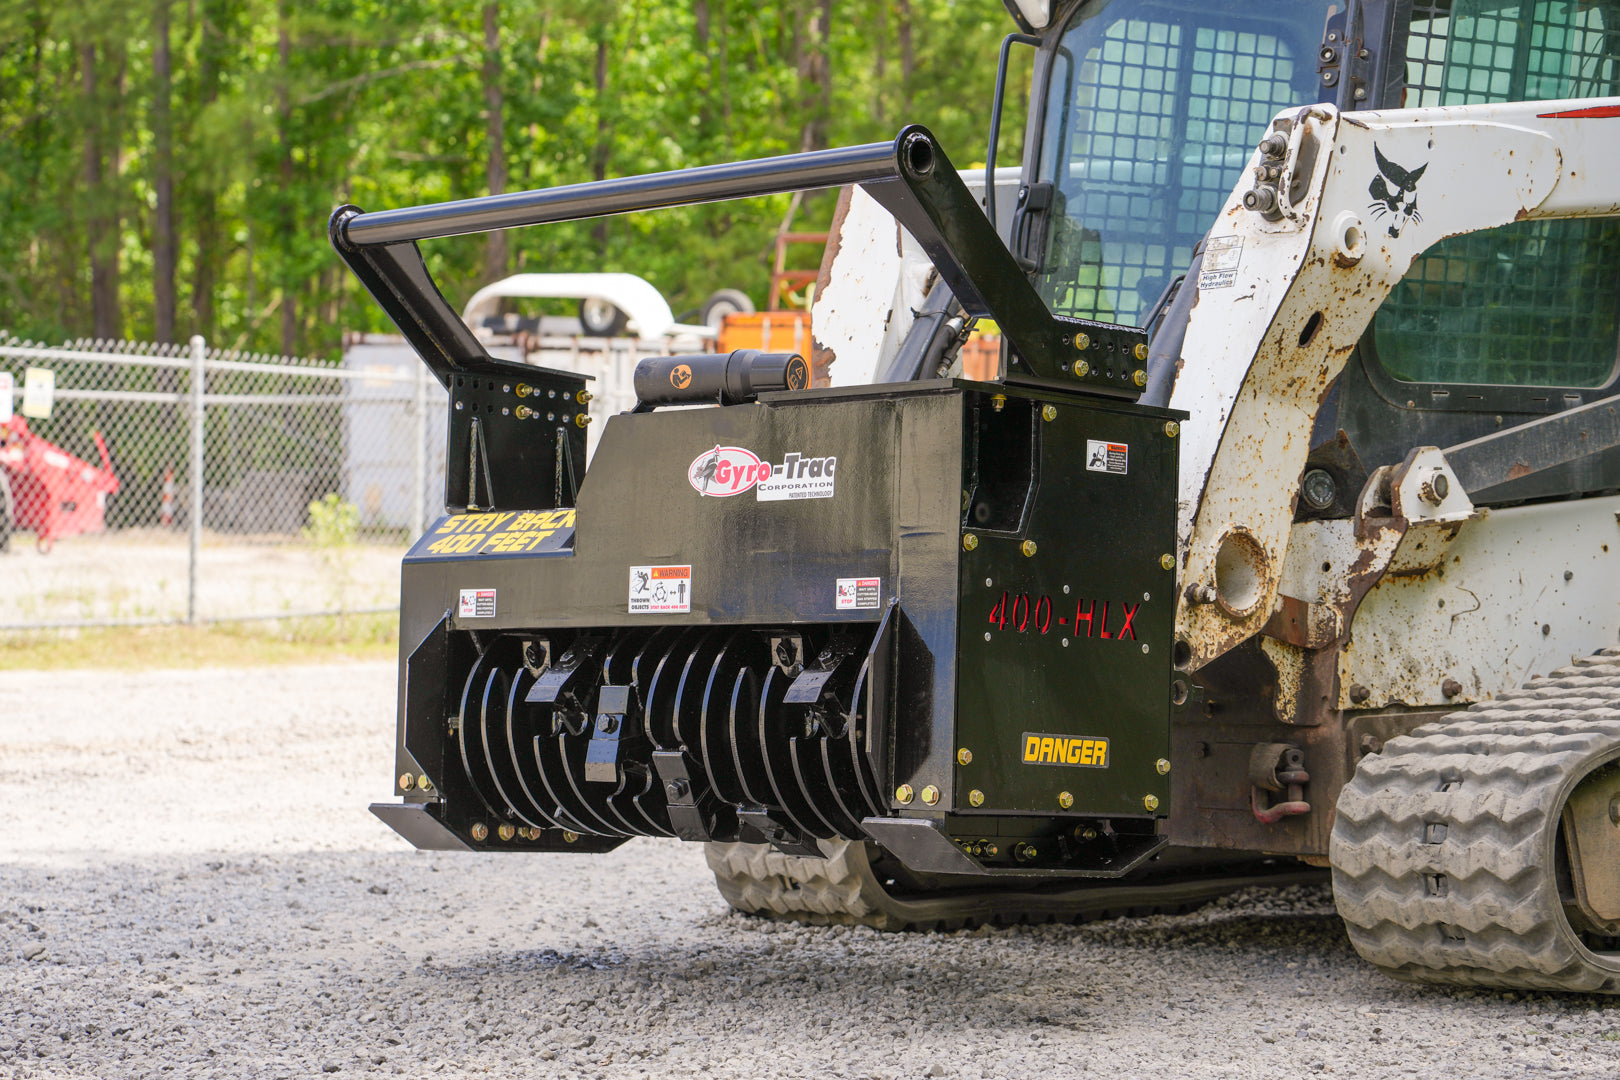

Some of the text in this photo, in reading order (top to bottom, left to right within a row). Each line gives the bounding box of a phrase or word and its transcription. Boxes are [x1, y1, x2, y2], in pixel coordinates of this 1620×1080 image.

[715, 454, 835, 490] Gyro-Trac
[758, 481, 833, 491] CORPORATION
[435, 508, 577, 534] STAY BACK
[427, 530, 556, 554] 400 FEET
[659, 569, 689, 577] WARNING
[988, 591, 1141, 641] 400-HLX
[1024, 736, 1107, 766] DANGER
